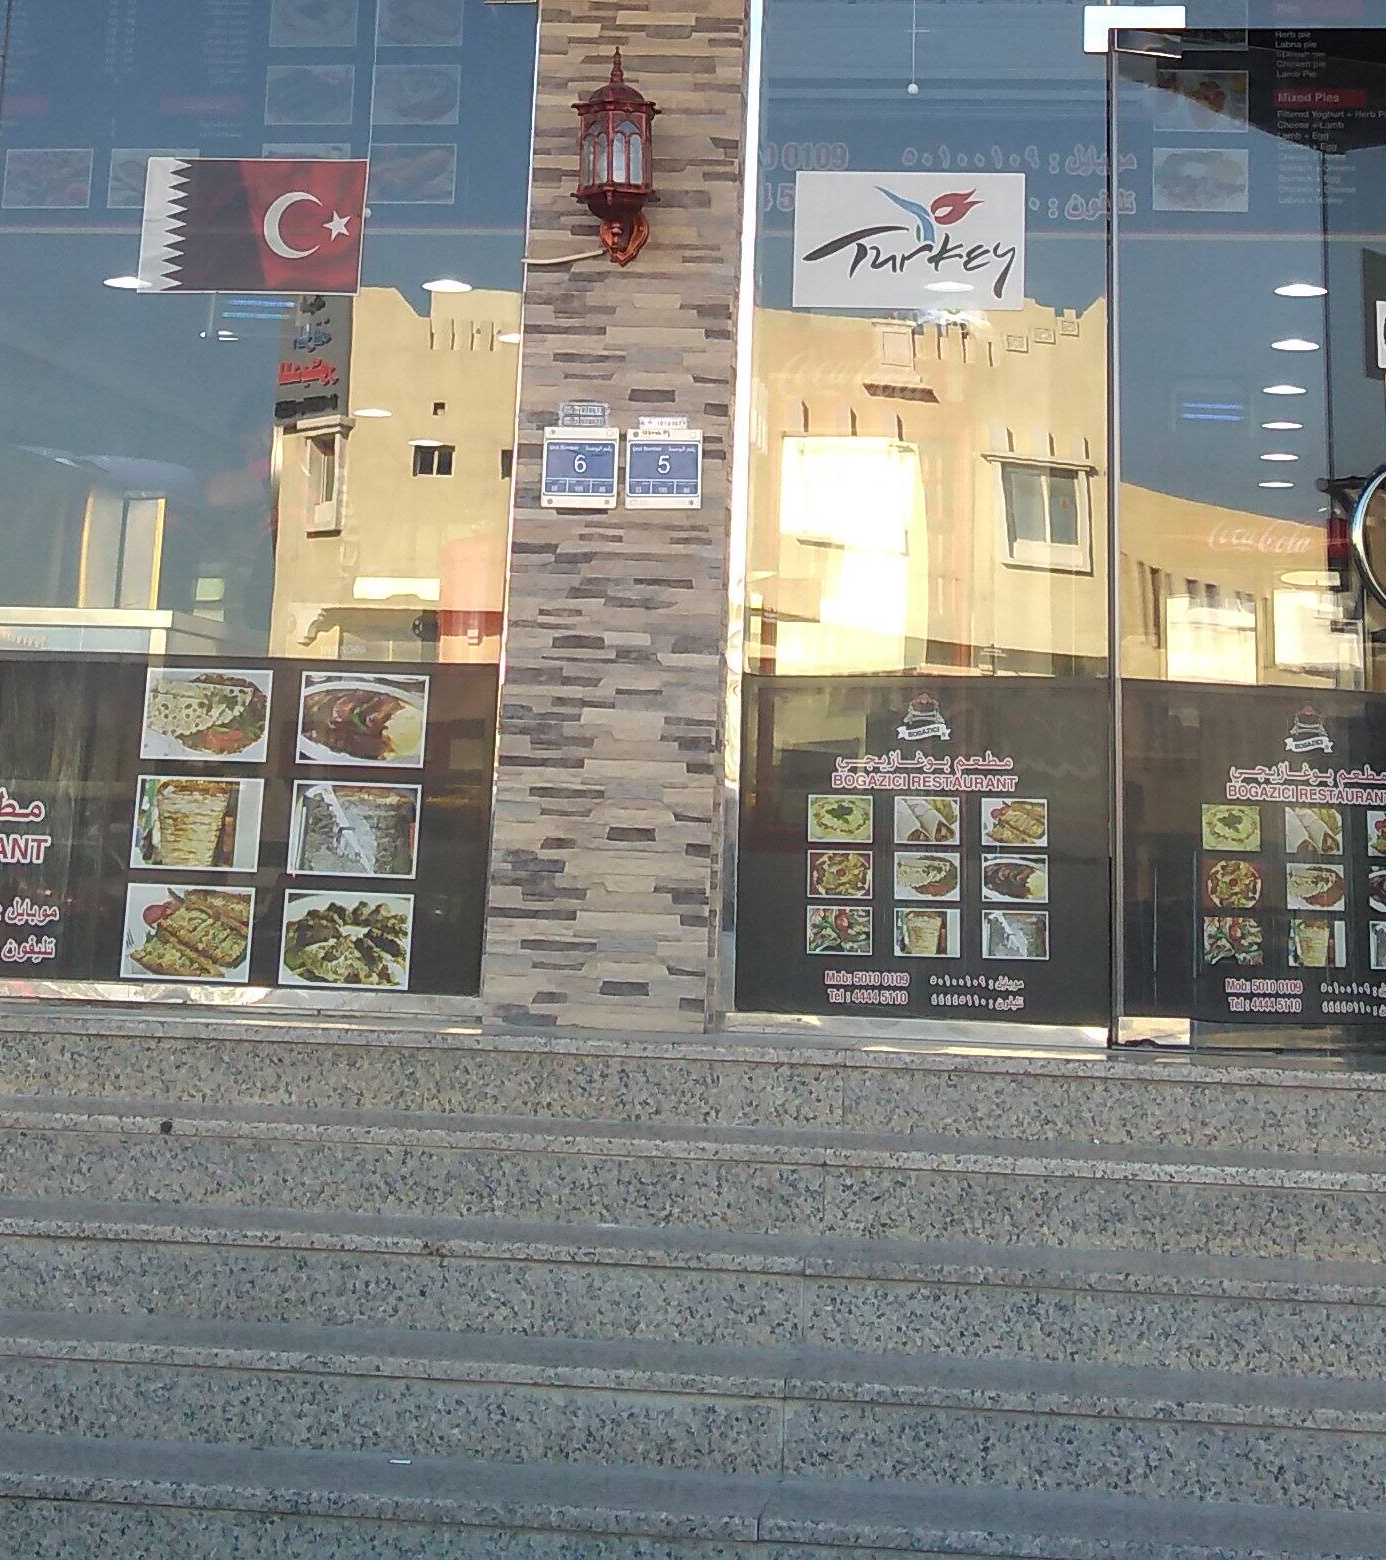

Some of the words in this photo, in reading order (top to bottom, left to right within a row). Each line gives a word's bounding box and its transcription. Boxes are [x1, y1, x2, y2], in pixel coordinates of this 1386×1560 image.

[801, 225, 1016, 299] Turkey
[573, 454, 588, 473] 6
[657, 455, 671, 474] 5
[953, 751, 1014, 776] مطعم
[831, 772, 909, 790] BOGAZICI
[909, 774, 1019, 792] RESTAURANT
[1225, 783, 1297, 801] BOGAZICI
[853, 971, 882, 986] 5010
[881, 972, 911, 987] 0109
[1251, 978, 1278, 994] 5010
[1276, 980, 1304, 995] 0109
[851, 990, 880, 1004] 4444
[880, 990, 909, 1005] 5110
[1250, 997, 1277, 1012] 4444
[1276, 998, 1303, 1013] 5110
